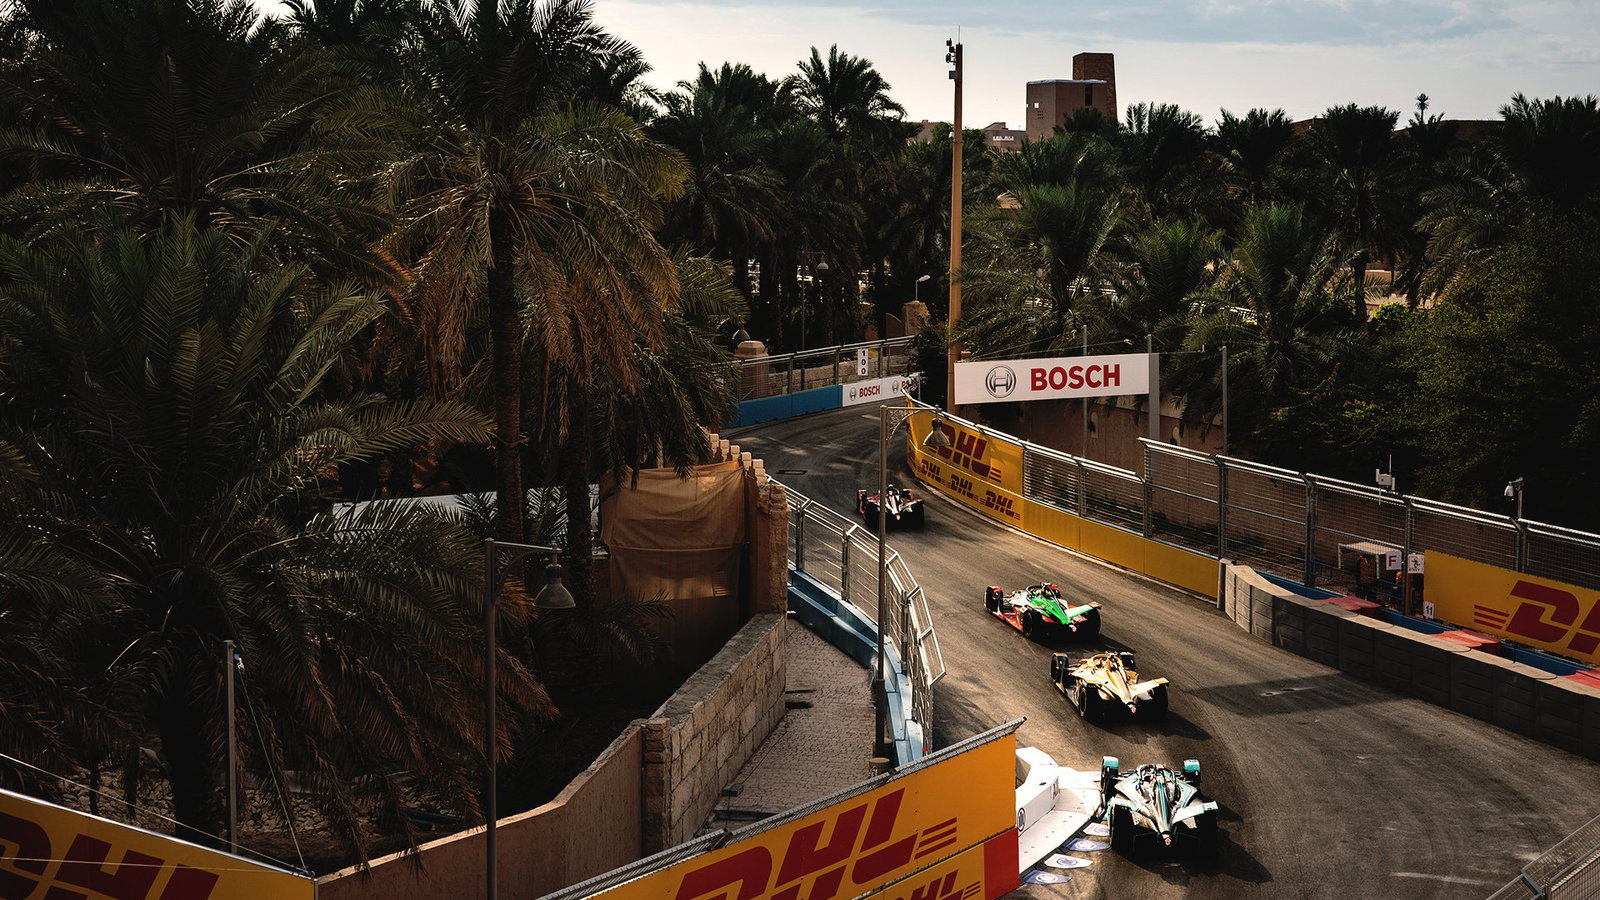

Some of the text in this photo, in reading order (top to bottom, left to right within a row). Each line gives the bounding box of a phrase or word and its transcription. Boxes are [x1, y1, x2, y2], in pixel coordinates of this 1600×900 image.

[1031, 363, 1121, 392] BOSCH
[859, 385, 881, 398] BOSCH
[936, 423, 991, 477] DHL
[921, 459, 942, 483] DHL
[950, 474, 974, 498] DHL
[985, 490, 1015, 517] DHL
[1388, 555, 1397, 567] F
[1426, 605, 1433, 616] 11
